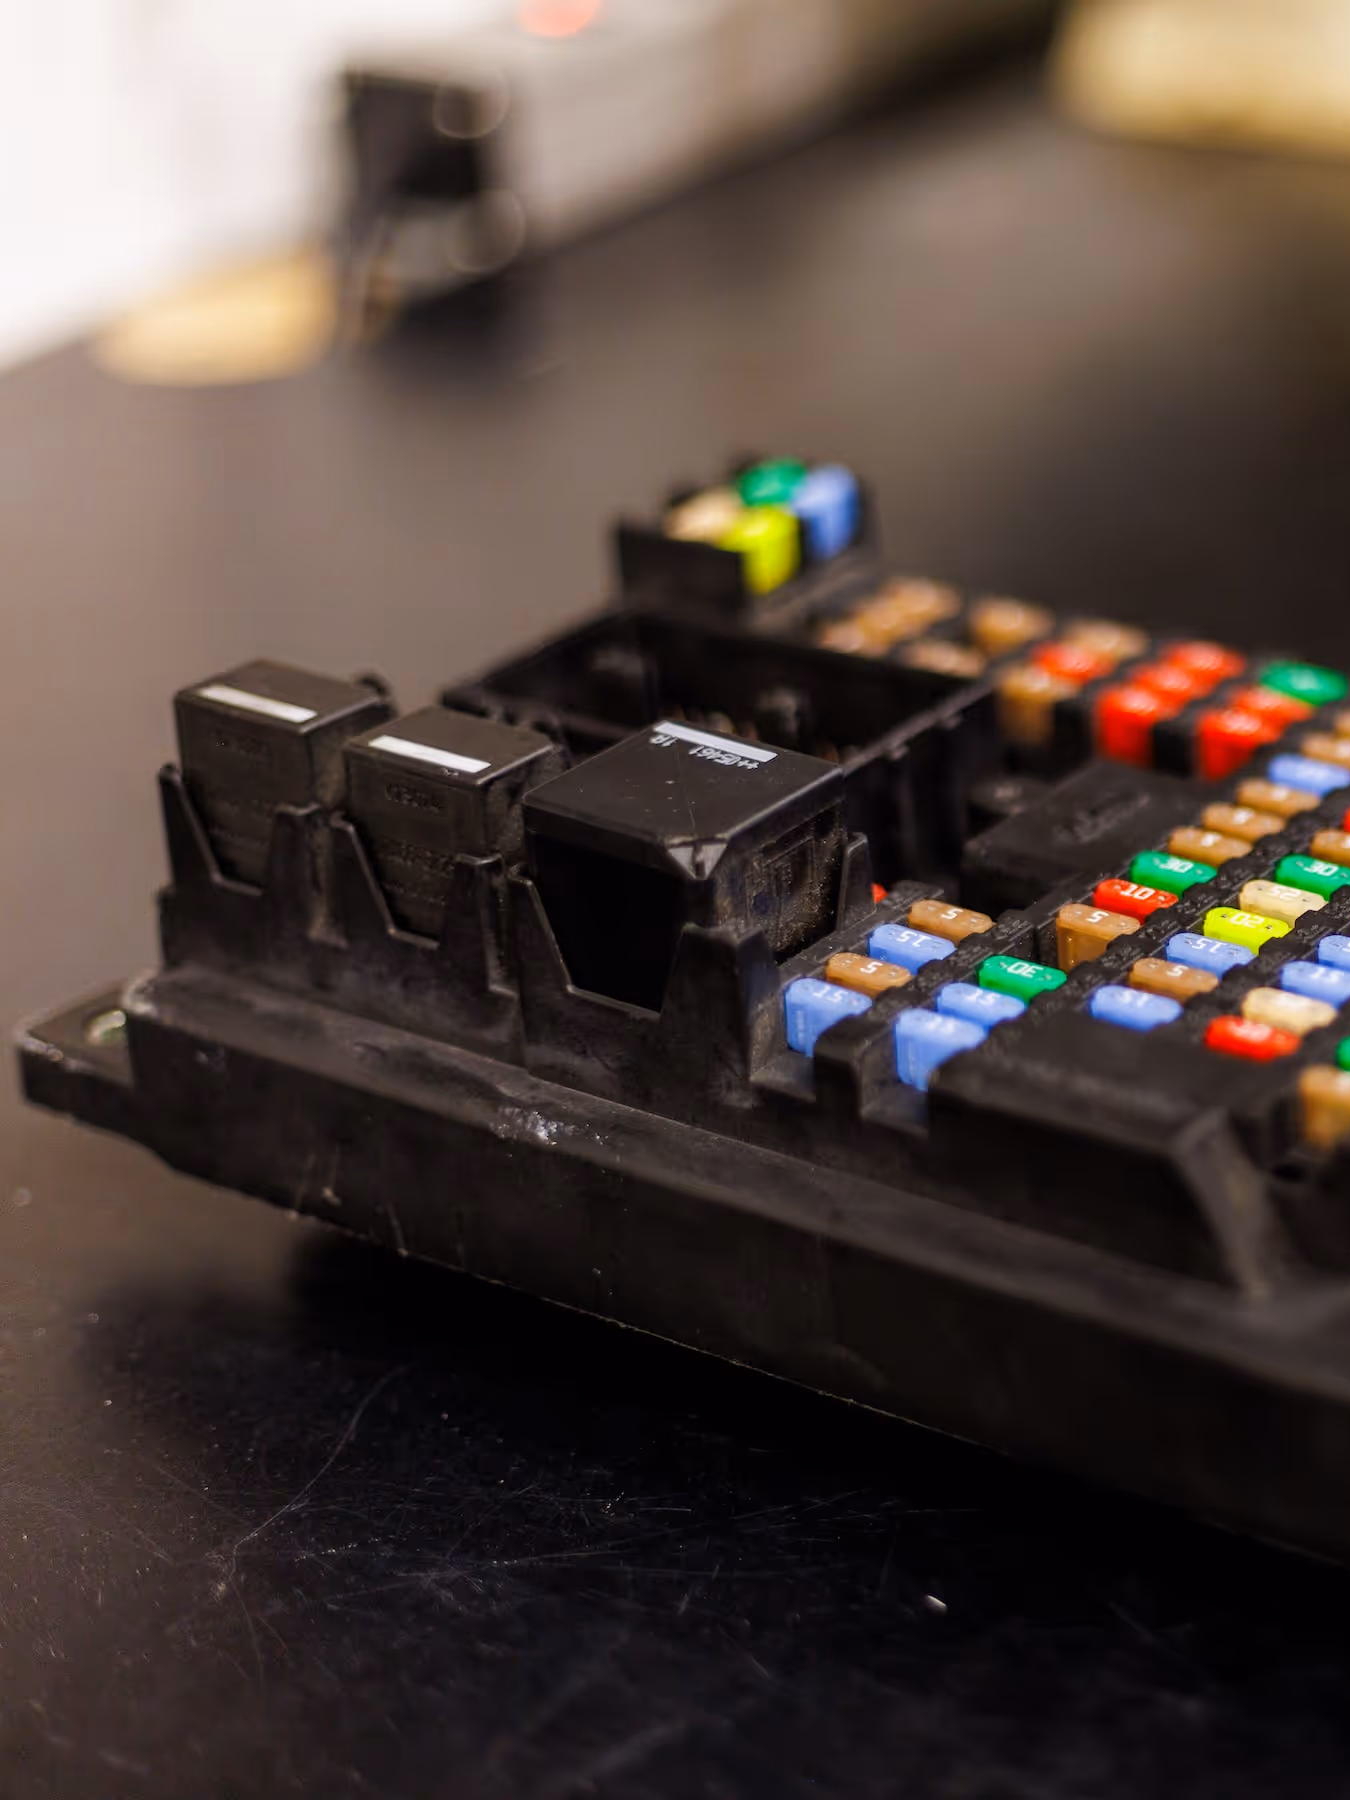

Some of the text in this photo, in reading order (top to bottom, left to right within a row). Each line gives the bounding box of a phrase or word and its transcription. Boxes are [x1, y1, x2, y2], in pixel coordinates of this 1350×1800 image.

[1159, 856, 1194, 873] 30
[1303, 862, 1339, 877] 30
[1120, 885, 1155, 900] 10
[941, 907, 963, 920] 5
[1085, 911, 1110, 923] 5
[1229, 912, 1265, 929] 20
[897, 930, 931, 948] 15
[1191, 938, 1228, 954] 15
[860, 961, 883, 974] 5
[1007, 961, 1043, 979] 30
[1166, 965, 1190, 977] 5
[1309, 967, 1343, 984] 15
[813, 985, 848, 1003] 15
